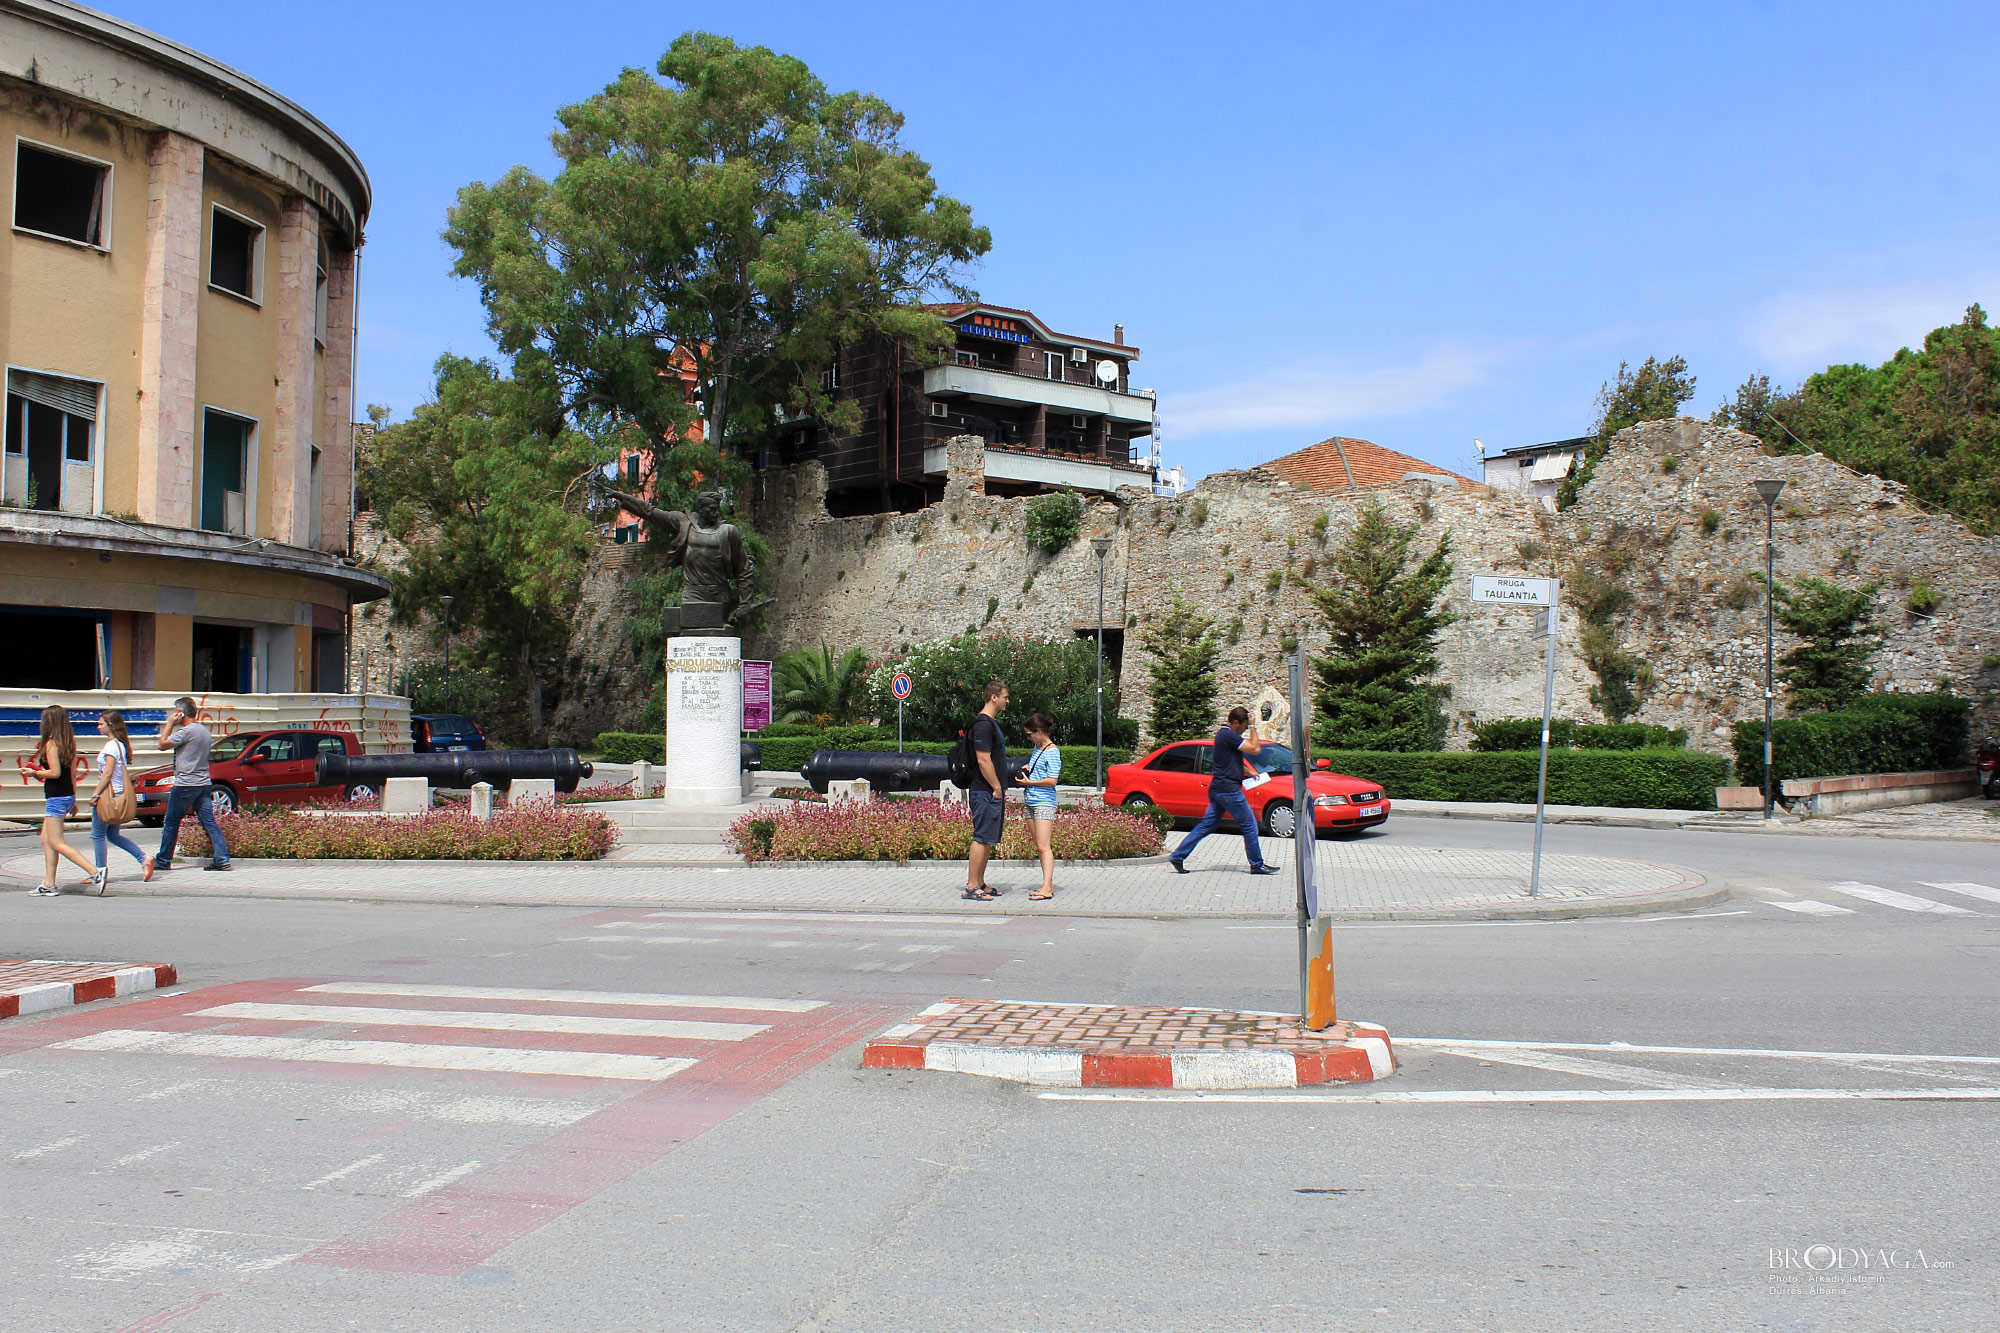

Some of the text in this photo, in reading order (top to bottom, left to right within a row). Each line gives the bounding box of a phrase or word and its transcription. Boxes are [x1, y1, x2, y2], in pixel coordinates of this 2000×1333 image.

[974, 315, 1016, 331] HOTEL
[960, 323, 1029, 343] MEDITERRAN
[1497, 579, 1525, 587] RRUGA
[1484, 590, 1538, 600] TAULANTIA
